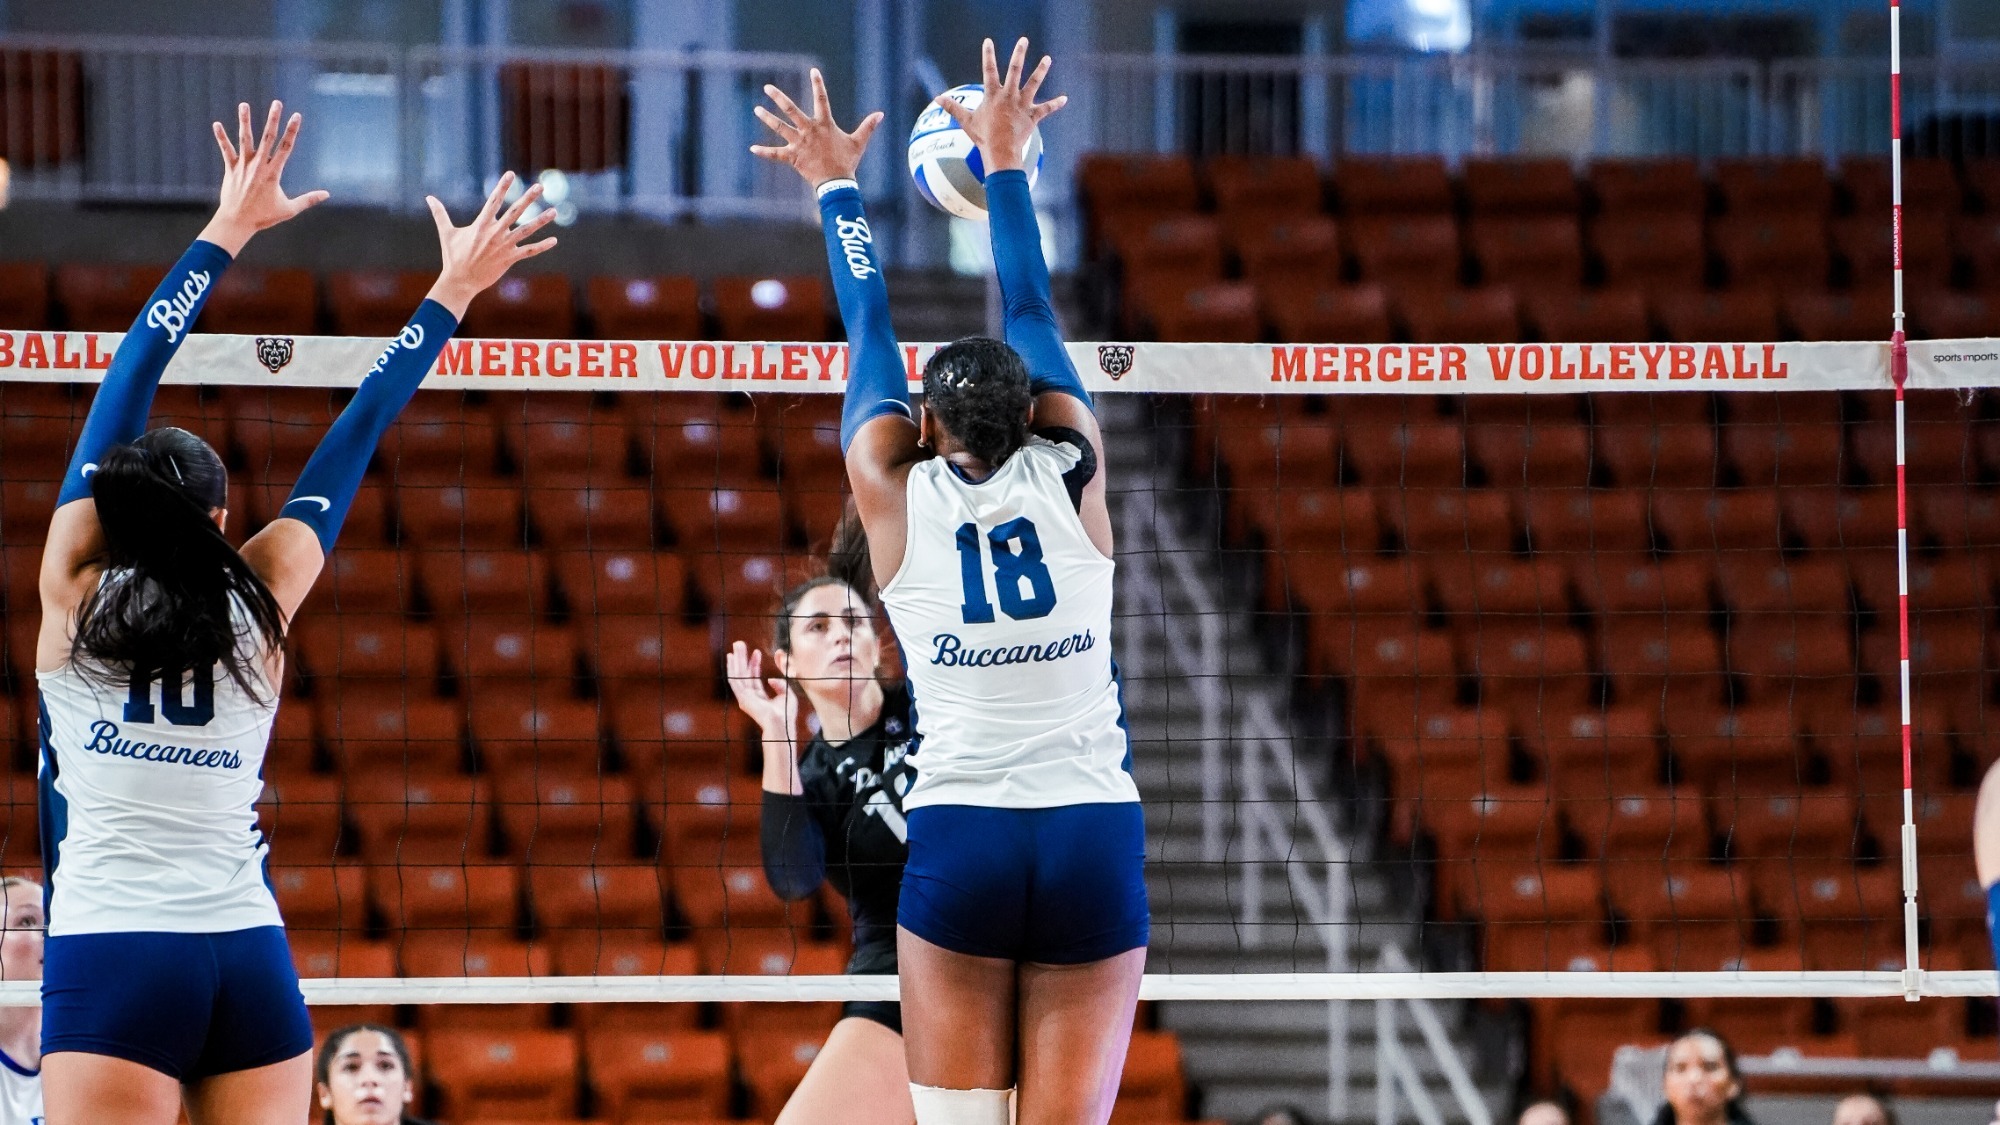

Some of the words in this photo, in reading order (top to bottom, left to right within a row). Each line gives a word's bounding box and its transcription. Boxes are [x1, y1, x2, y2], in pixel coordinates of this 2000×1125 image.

[836, 214, 877, 280] Bucs
[146, 270, 211, 343] Bucs
[436, 340, 638, 378] MERCER
[1271, 345, 1467, 382] MERCER
[1487, 344, 1788, 381] VOLLEYBALL
[1933, 353, 1962, 363] sports
[1963, 352, 1999, 362] imports
[955, 516, 1057, 624] 18
[930, 628, 1096, 668] Buccaneers
[123, 650, 215, 727] 10
[84, 720, 243, 770] Buccaneers
